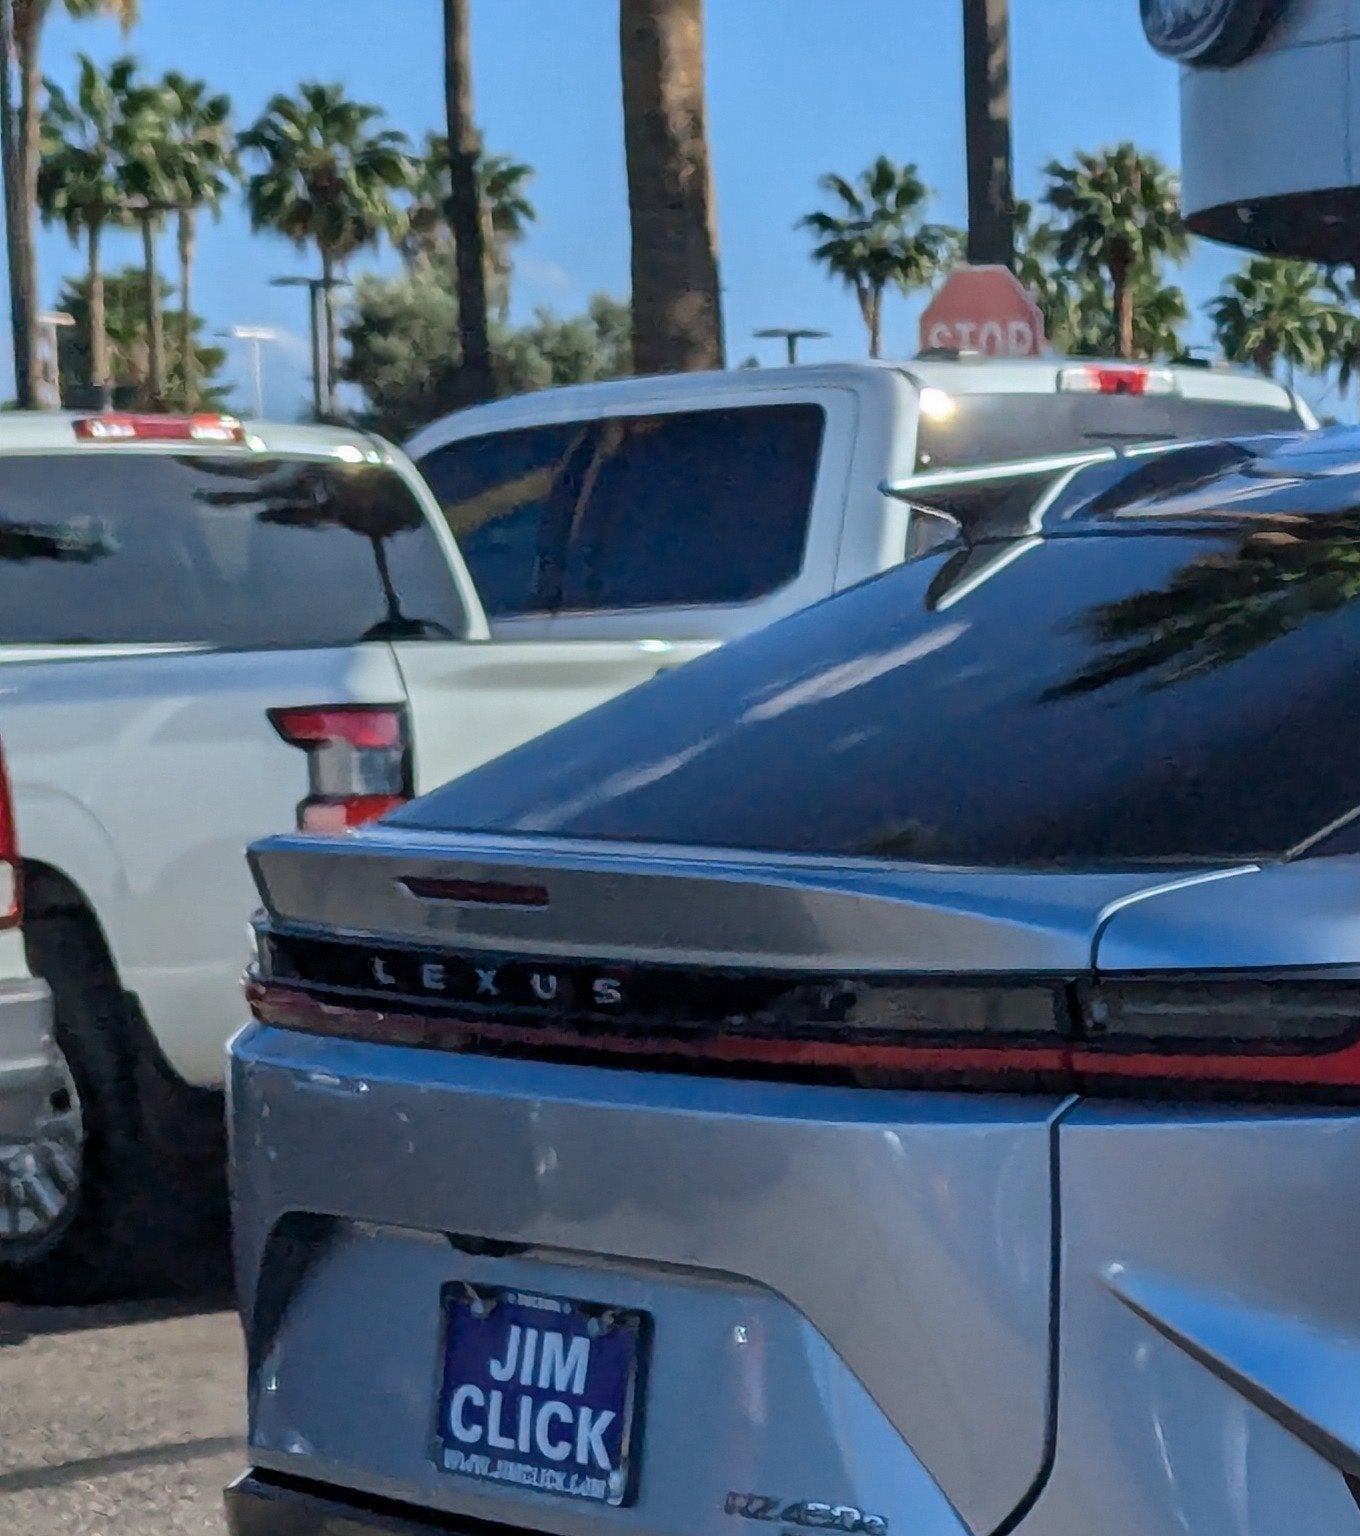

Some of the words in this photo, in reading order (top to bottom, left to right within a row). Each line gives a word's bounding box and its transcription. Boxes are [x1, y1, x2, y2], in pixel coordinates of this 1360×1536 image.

[370, 955, 622, 1005] LEXUS
[489, 1324, 591, 1396] JIM
[450, 1383, 617, 1471] CLICK
